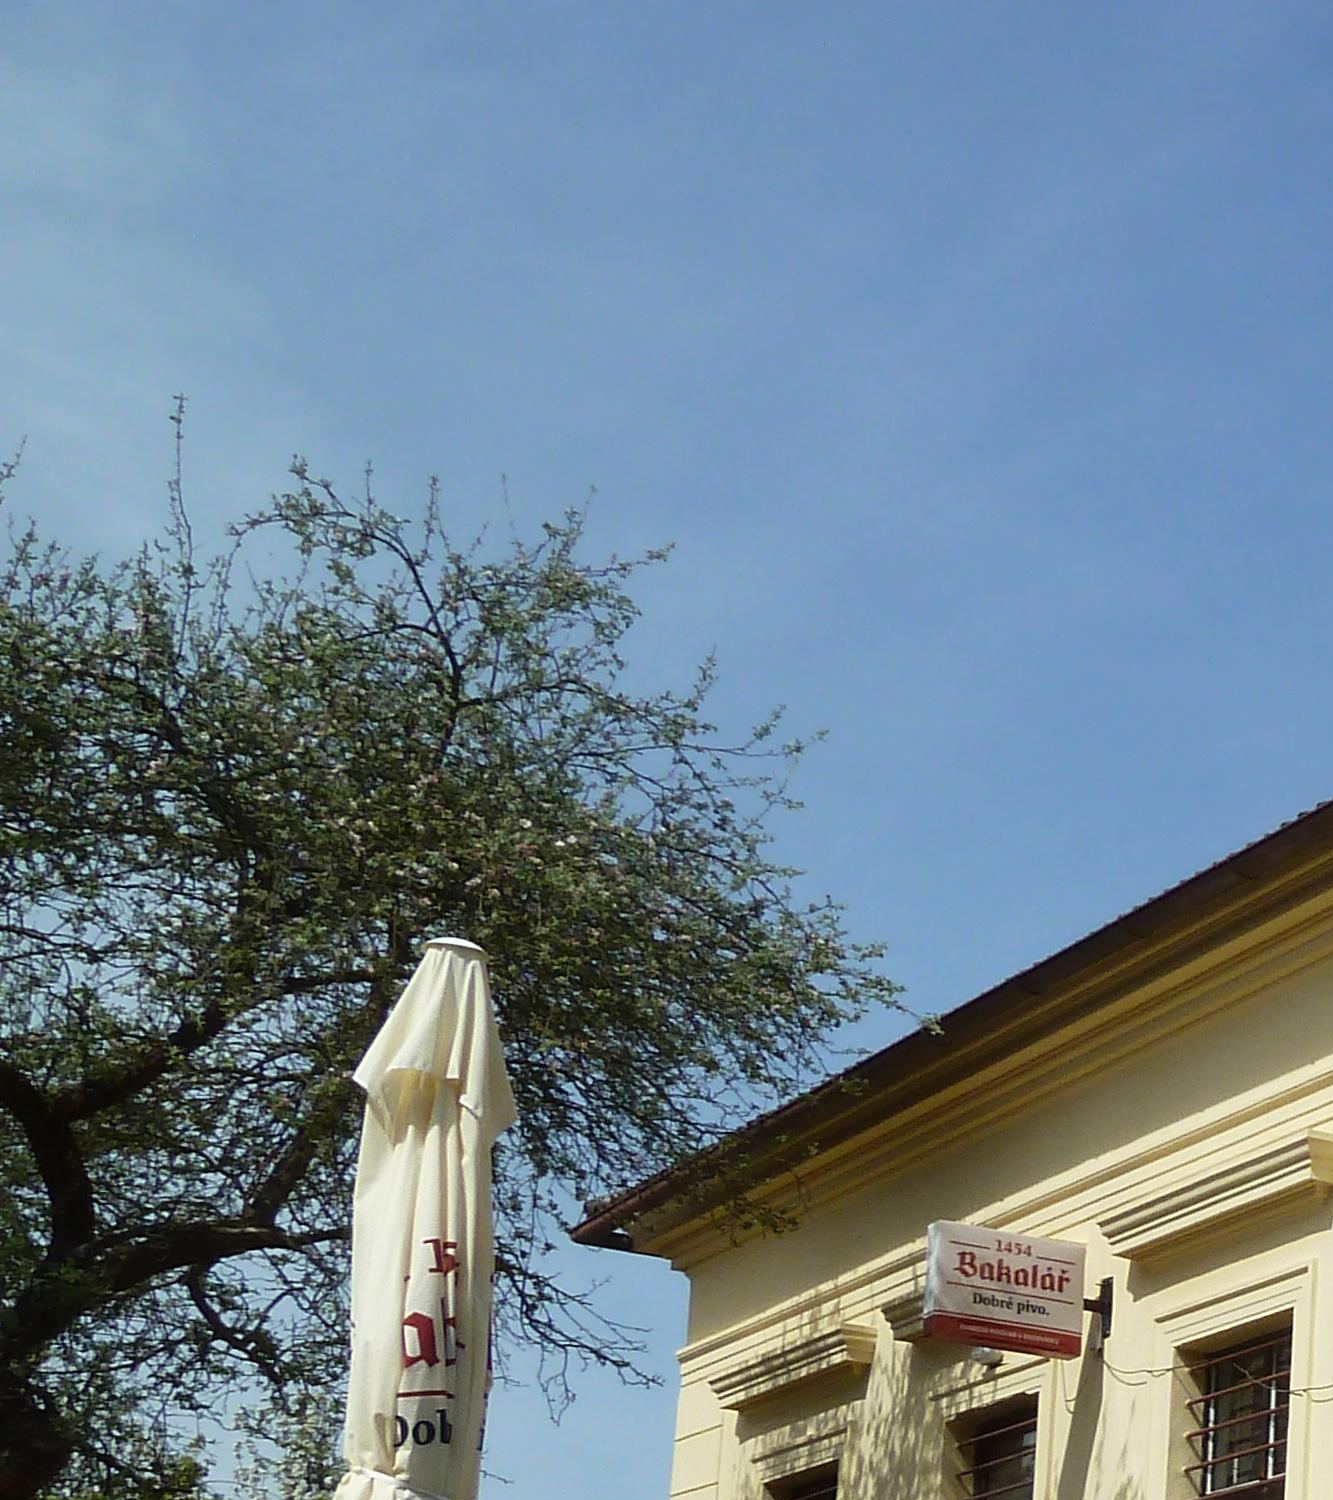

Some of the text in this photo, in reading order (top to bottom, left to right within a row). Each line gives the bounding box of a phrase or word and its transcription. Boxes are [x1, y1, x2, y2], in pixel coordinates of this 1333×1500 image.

[995, 1239, 1033, 1257] 1454
[953, 1250, 1071, 1294] Bakalář
[972, 1292, 1050, 1317] Dobré pivo.
